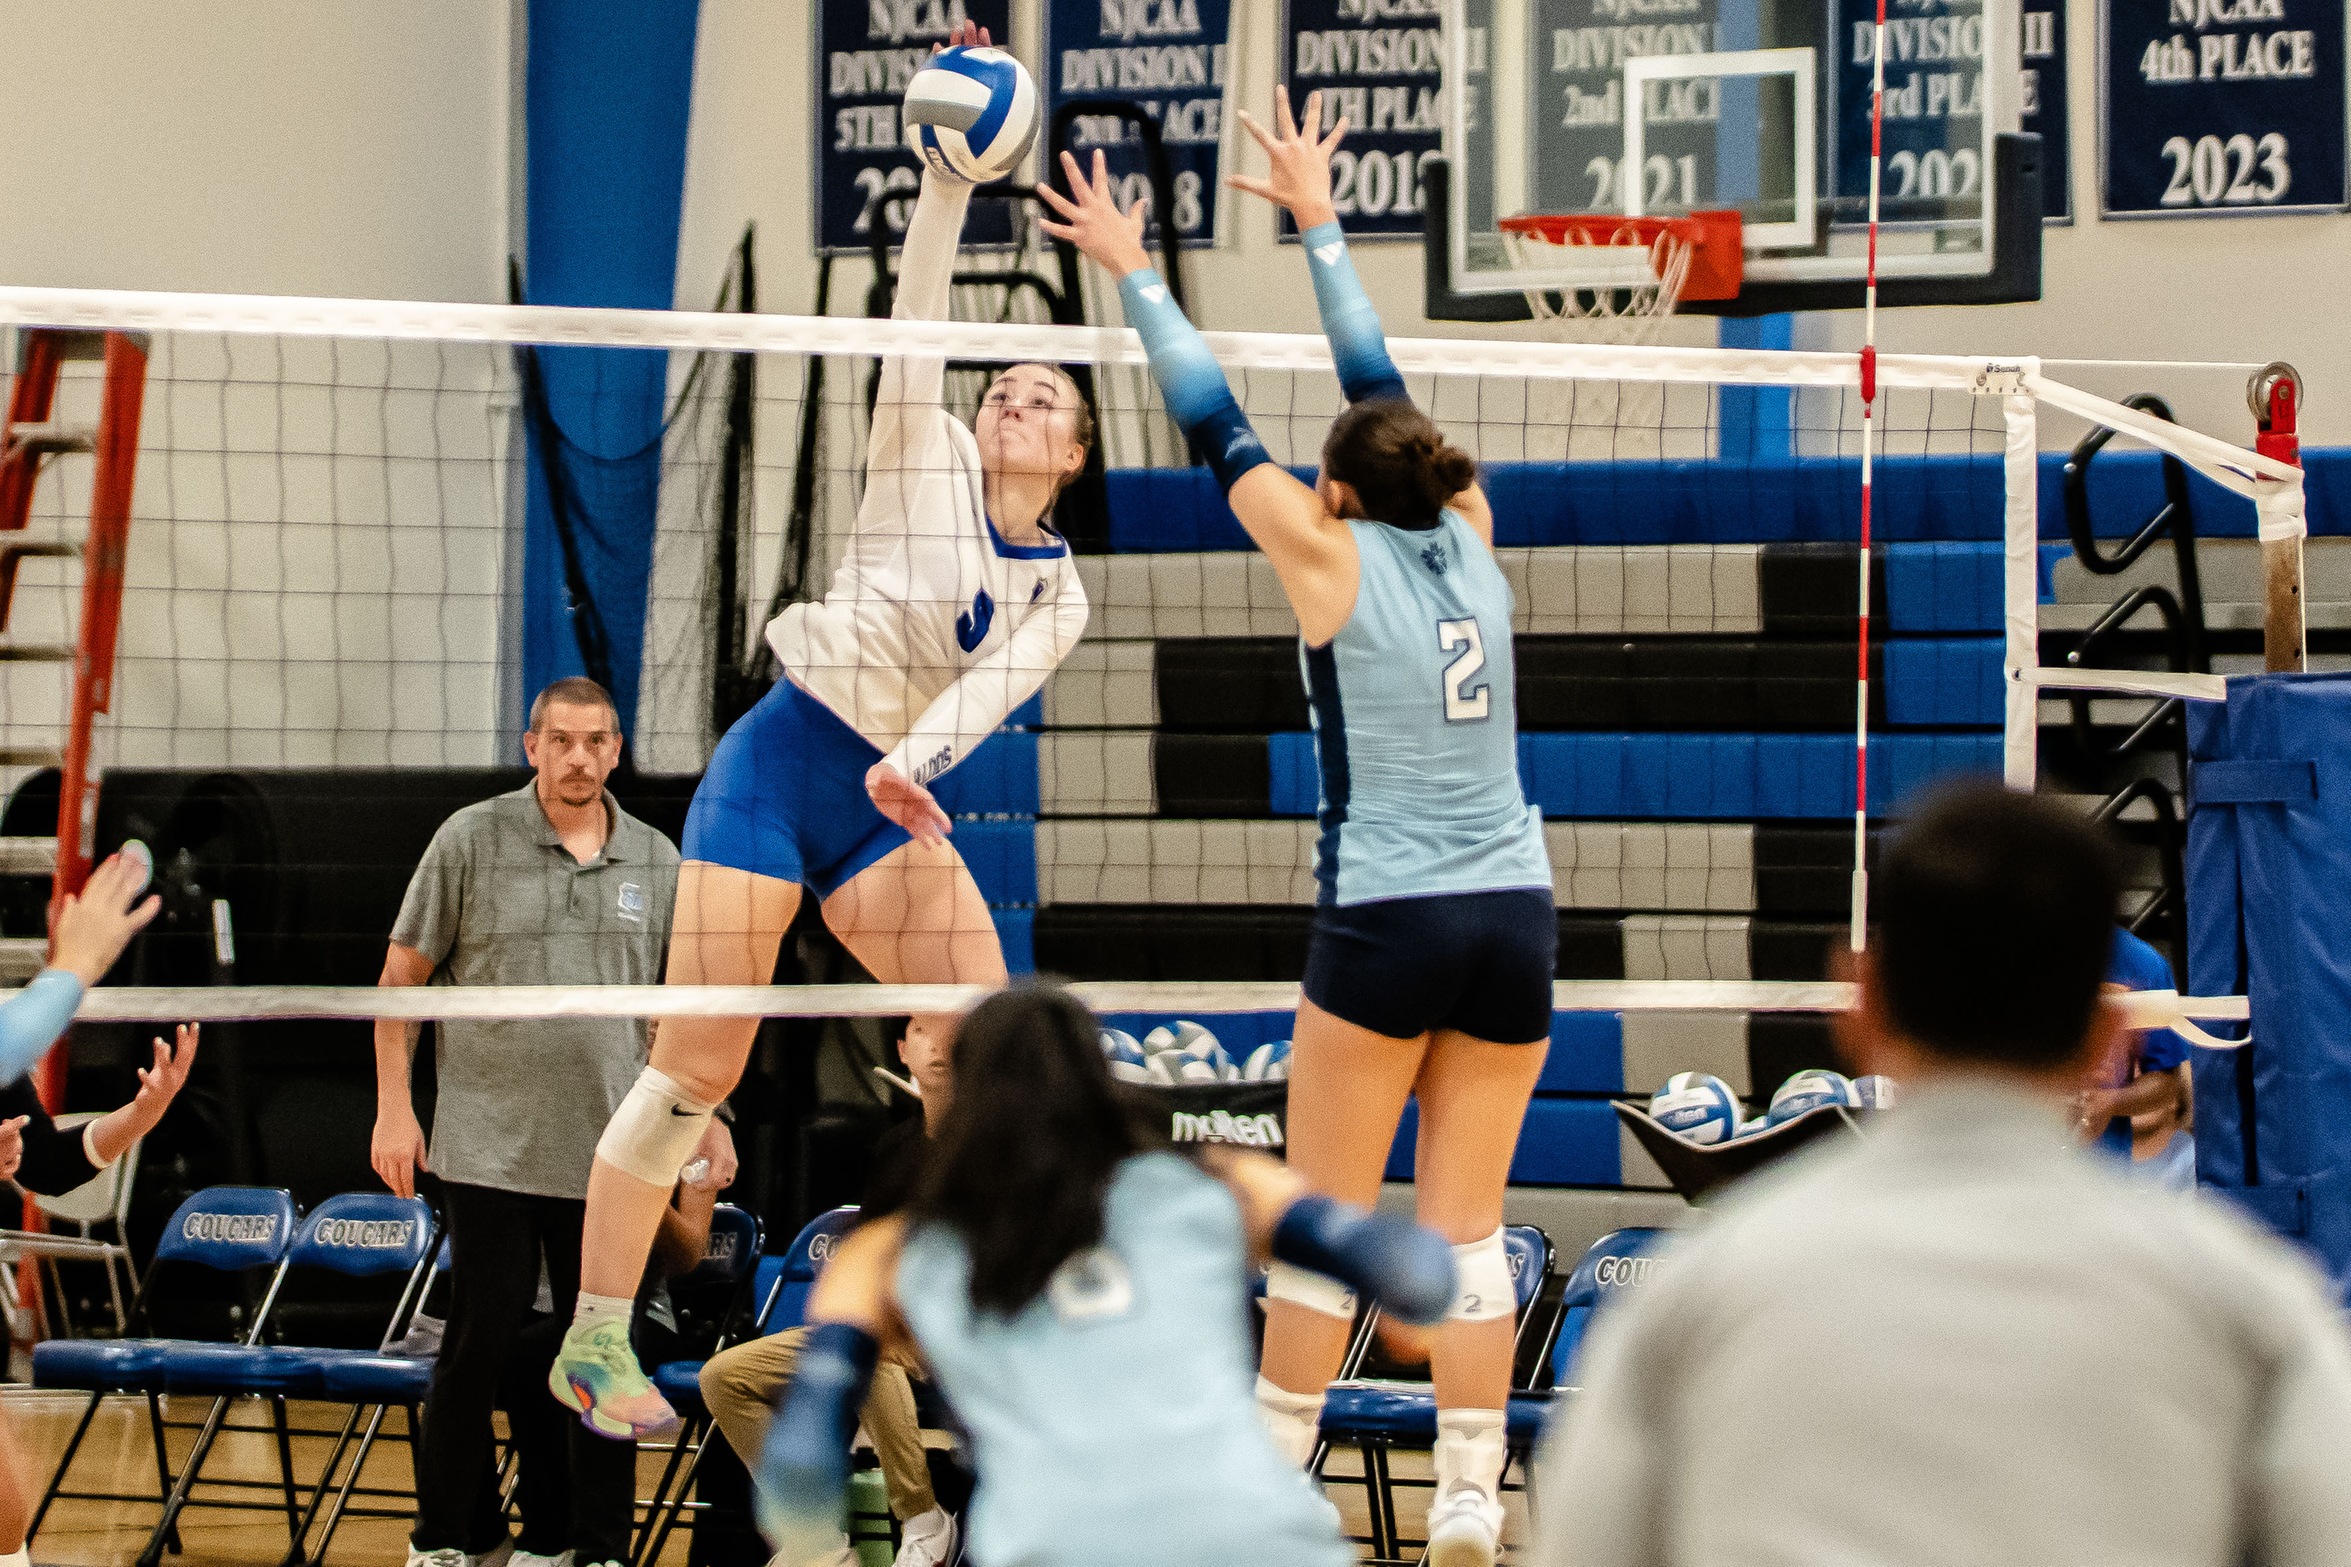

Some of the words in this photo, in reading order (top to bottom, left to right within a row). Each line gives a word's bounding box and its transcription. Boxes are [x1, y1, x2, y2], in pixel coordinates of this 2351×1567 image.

[1853, 15, 1985, 64] DIVISIO
[2139, 34, 2196, 83] 4th
[2198, 30, 2315, 82] PLACE
[1061, 44, 1207, 93] DIVISION
[1563, 79, 1620, 127] 2nd
[2159, 132, 2292, 206] 2023
[1437, 615, 1490, 723] 2
[1172, 1109, 1285, 1147] molten
[1464, 1294, 1482, 1313] 2
